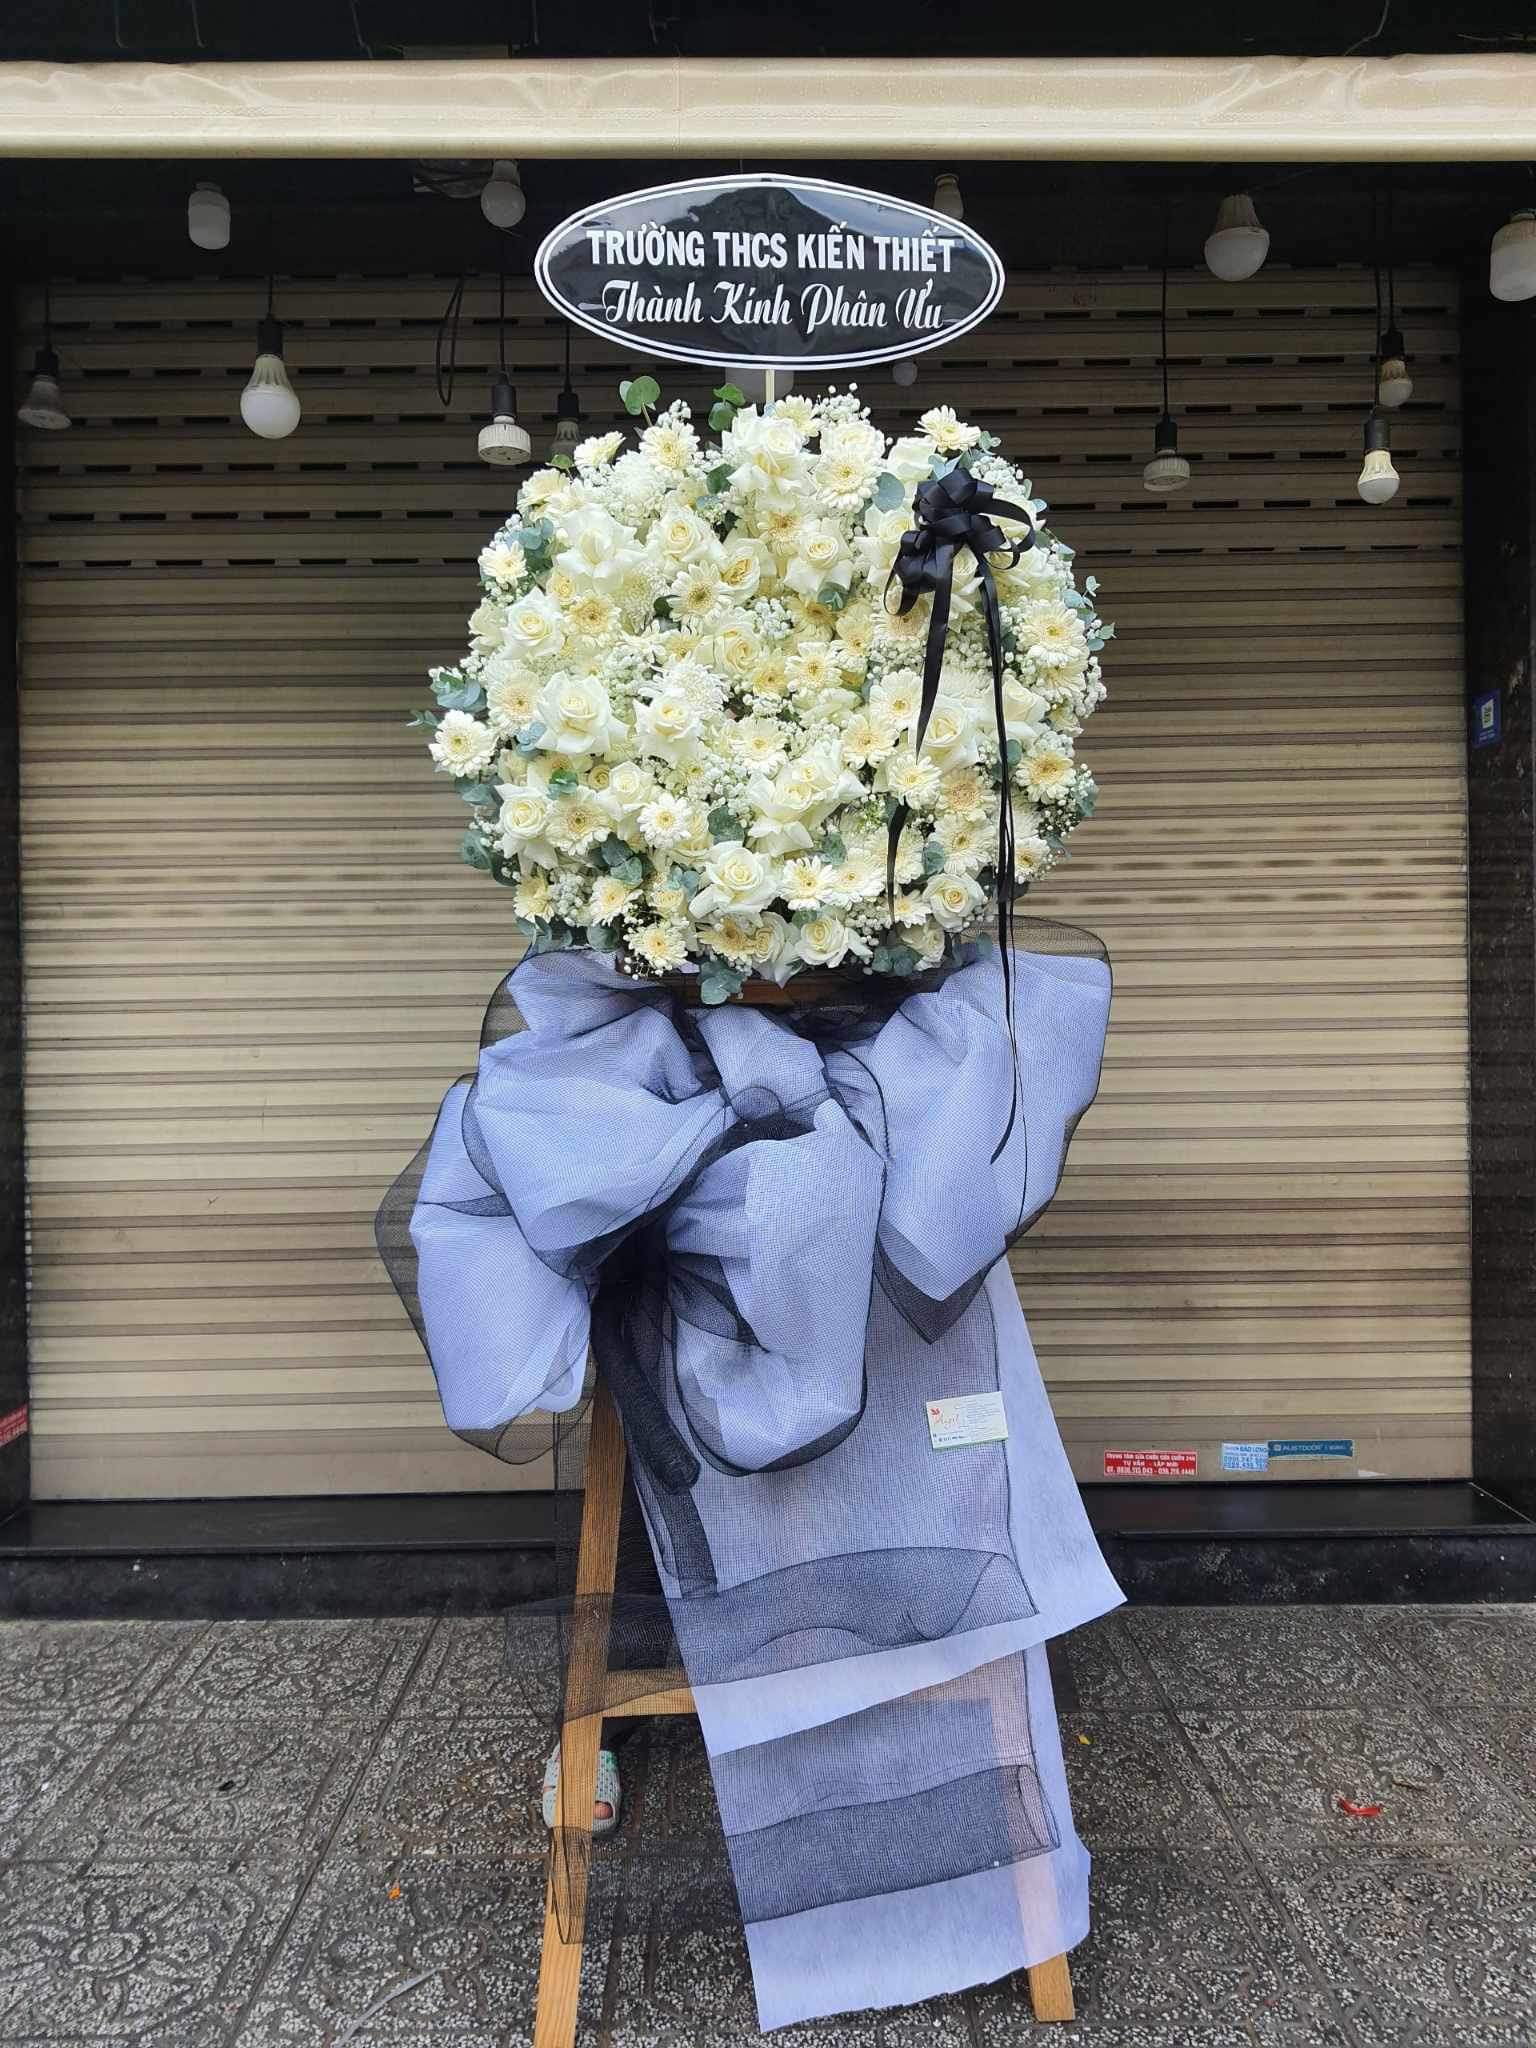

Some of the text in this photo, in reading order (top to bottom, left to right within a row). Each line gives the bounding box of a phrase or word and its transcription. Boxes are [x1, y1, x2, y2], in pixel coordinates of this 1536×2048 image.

[586, 221, 955, 273] TRƯỜNG THCS KIẾN THIẾT
[602, 278, 944, 335] Thành Kính Phân Ưu
